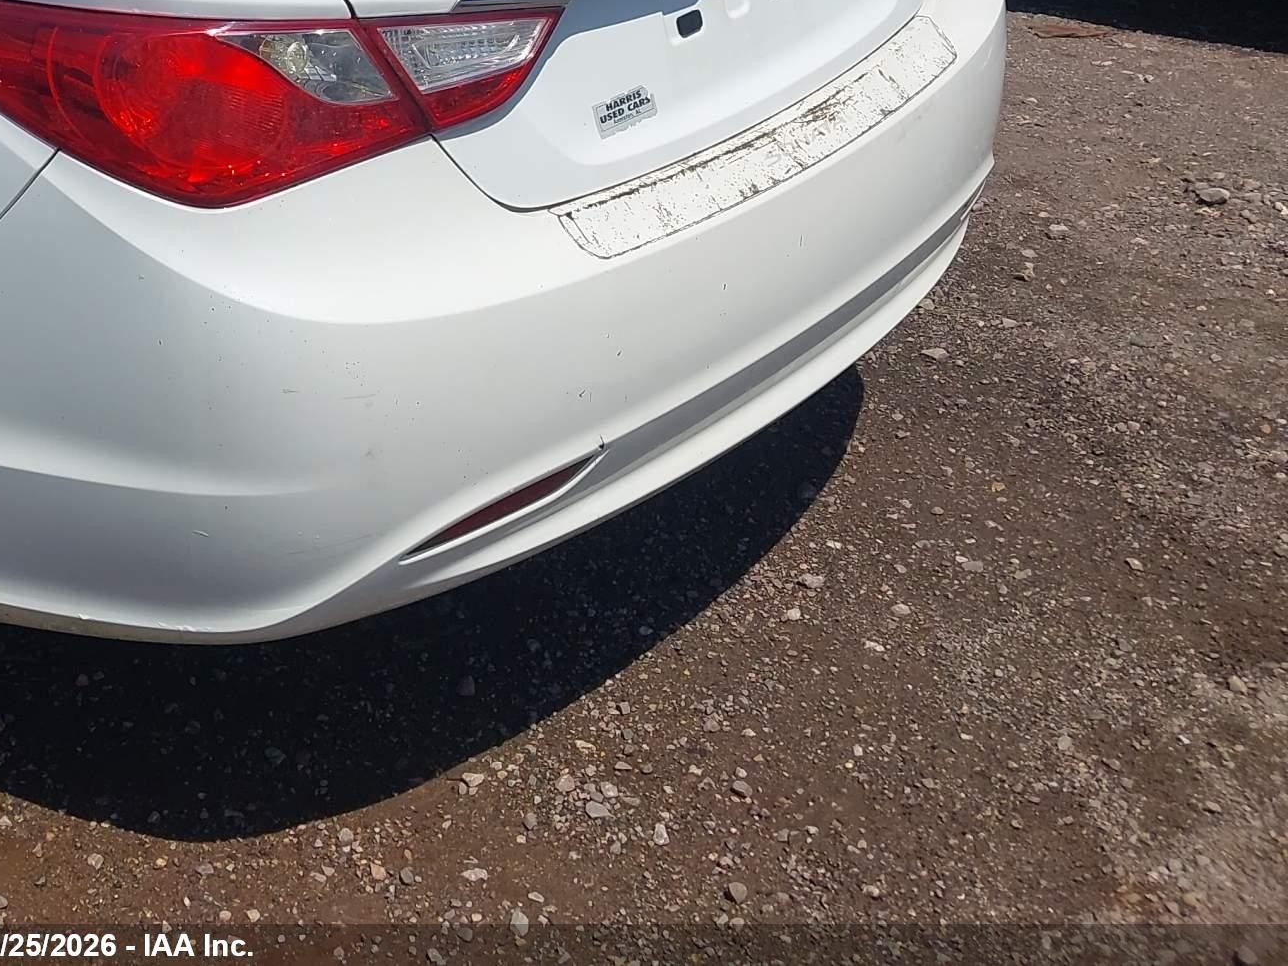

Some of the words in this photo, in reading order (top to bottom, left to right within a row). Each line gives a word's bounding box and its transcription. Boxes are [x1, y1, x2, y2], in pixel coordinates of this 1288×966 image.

[599, 108, 625, 124] USED
[627, 96, 651, 112] CARS
[605, 89, 642, 112] HARRIS
